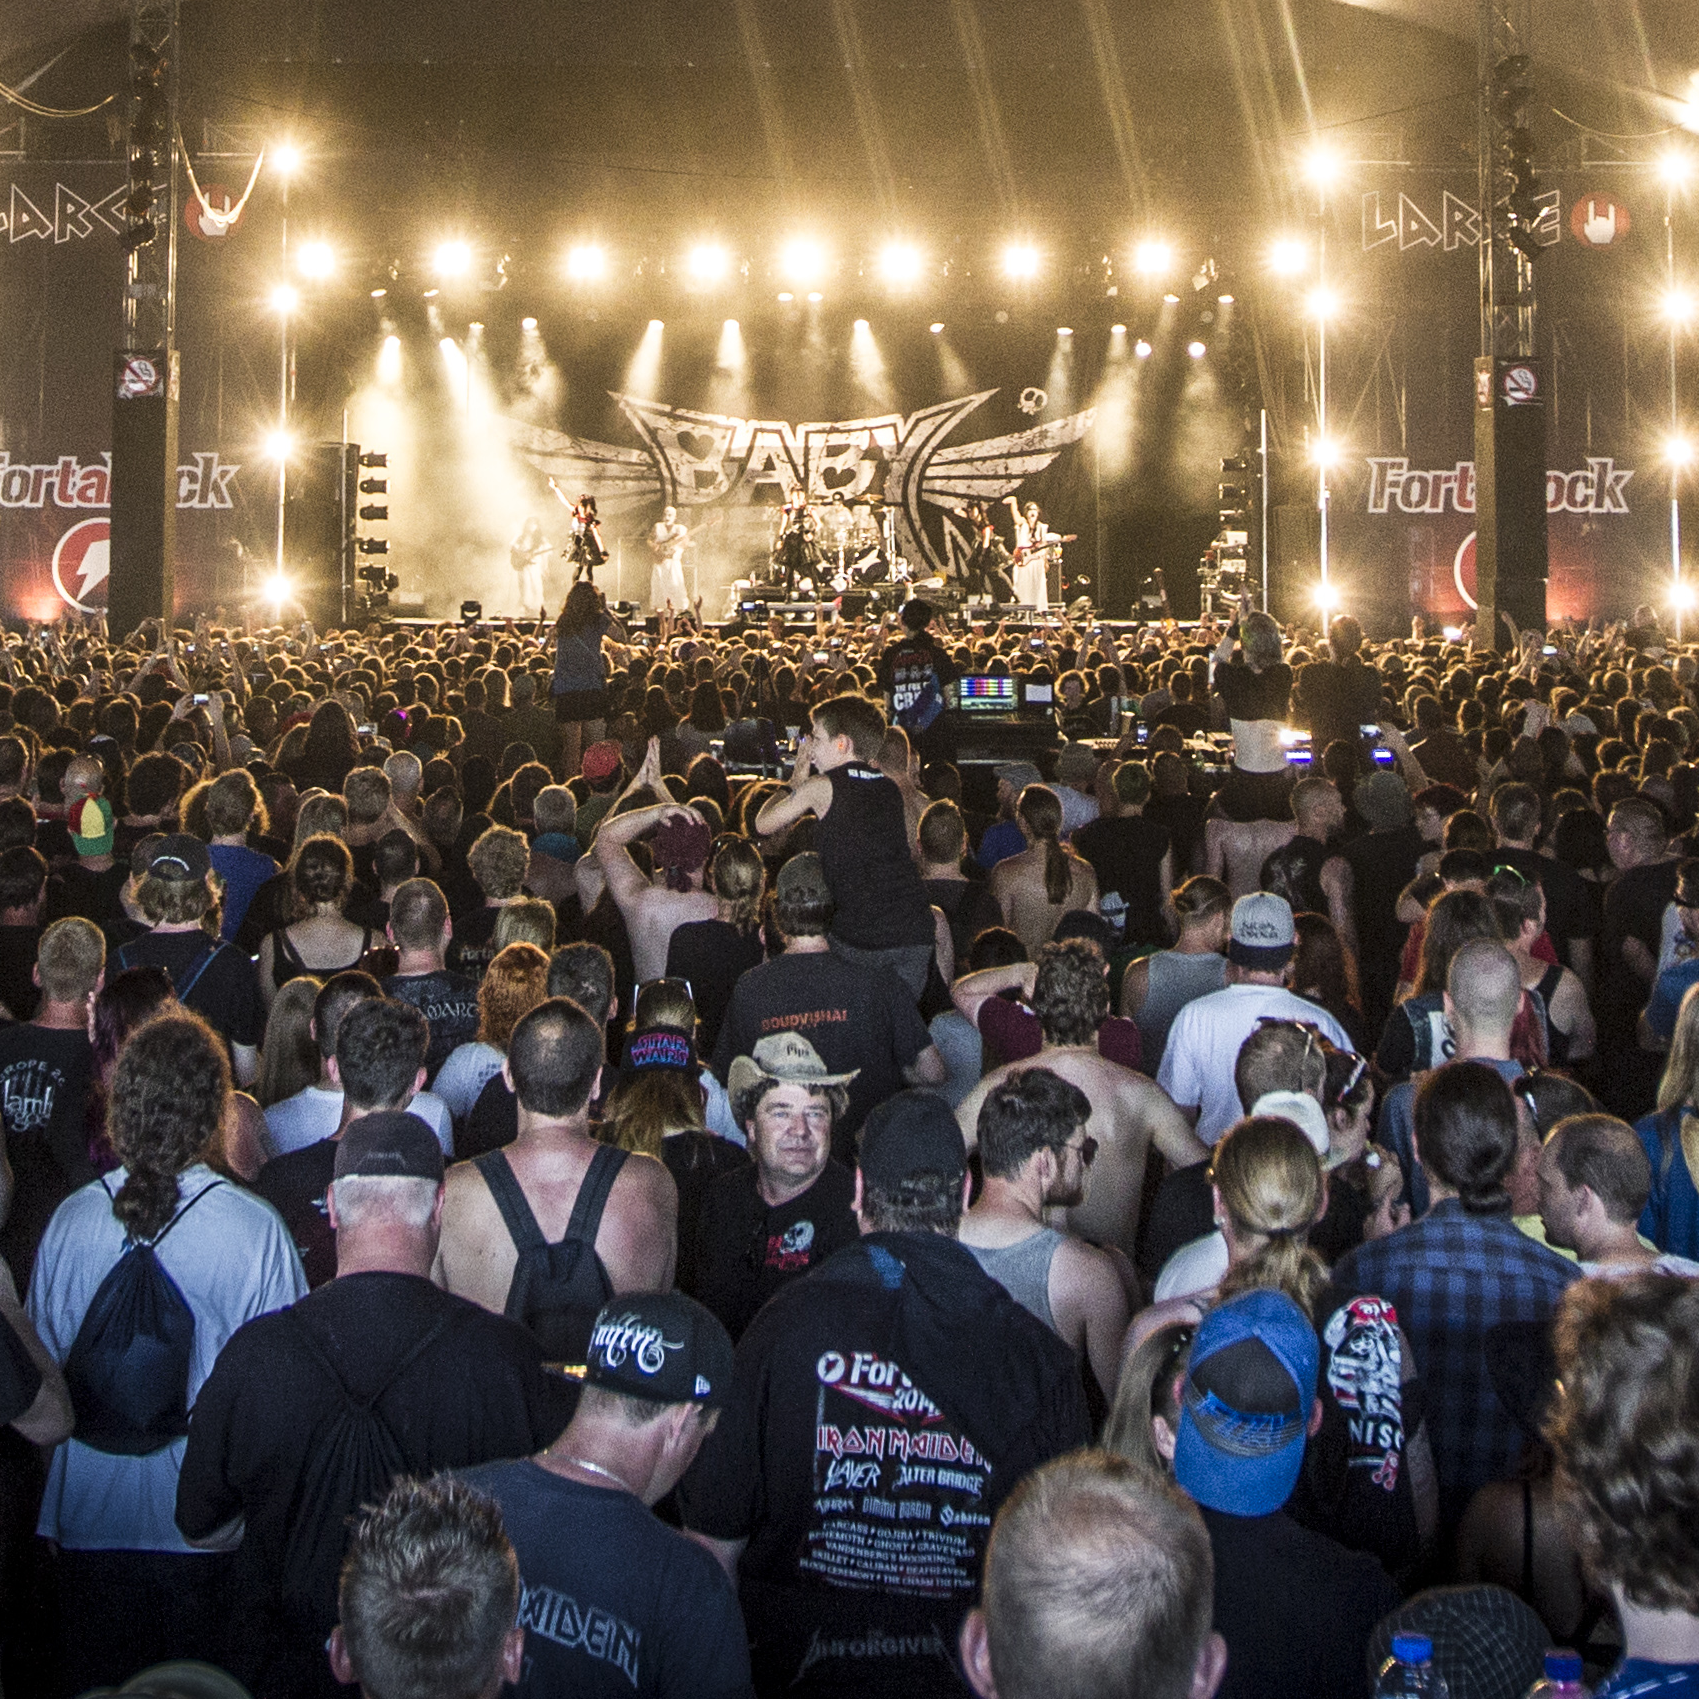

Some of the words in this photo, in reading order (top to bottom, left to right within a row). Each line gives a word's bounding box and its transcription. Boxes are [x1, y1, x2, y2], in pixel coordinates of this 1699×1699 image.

[1362, 189, 1561, 252] LARE
[1366, 456, 1636, 514] Fortock
[630, 1032, 689, 1049] STAR
[631, 1047, 689, 1067] WARS
[816, 1423, 886, 1461] IRON
[823, 1457, 882, 1493] SLAYER
[892, 1464, 937, 1492] ALTER
[937, 1467, 985, 1501] BRIDGE
[515, 1577, 642, 1688] AIDEN
